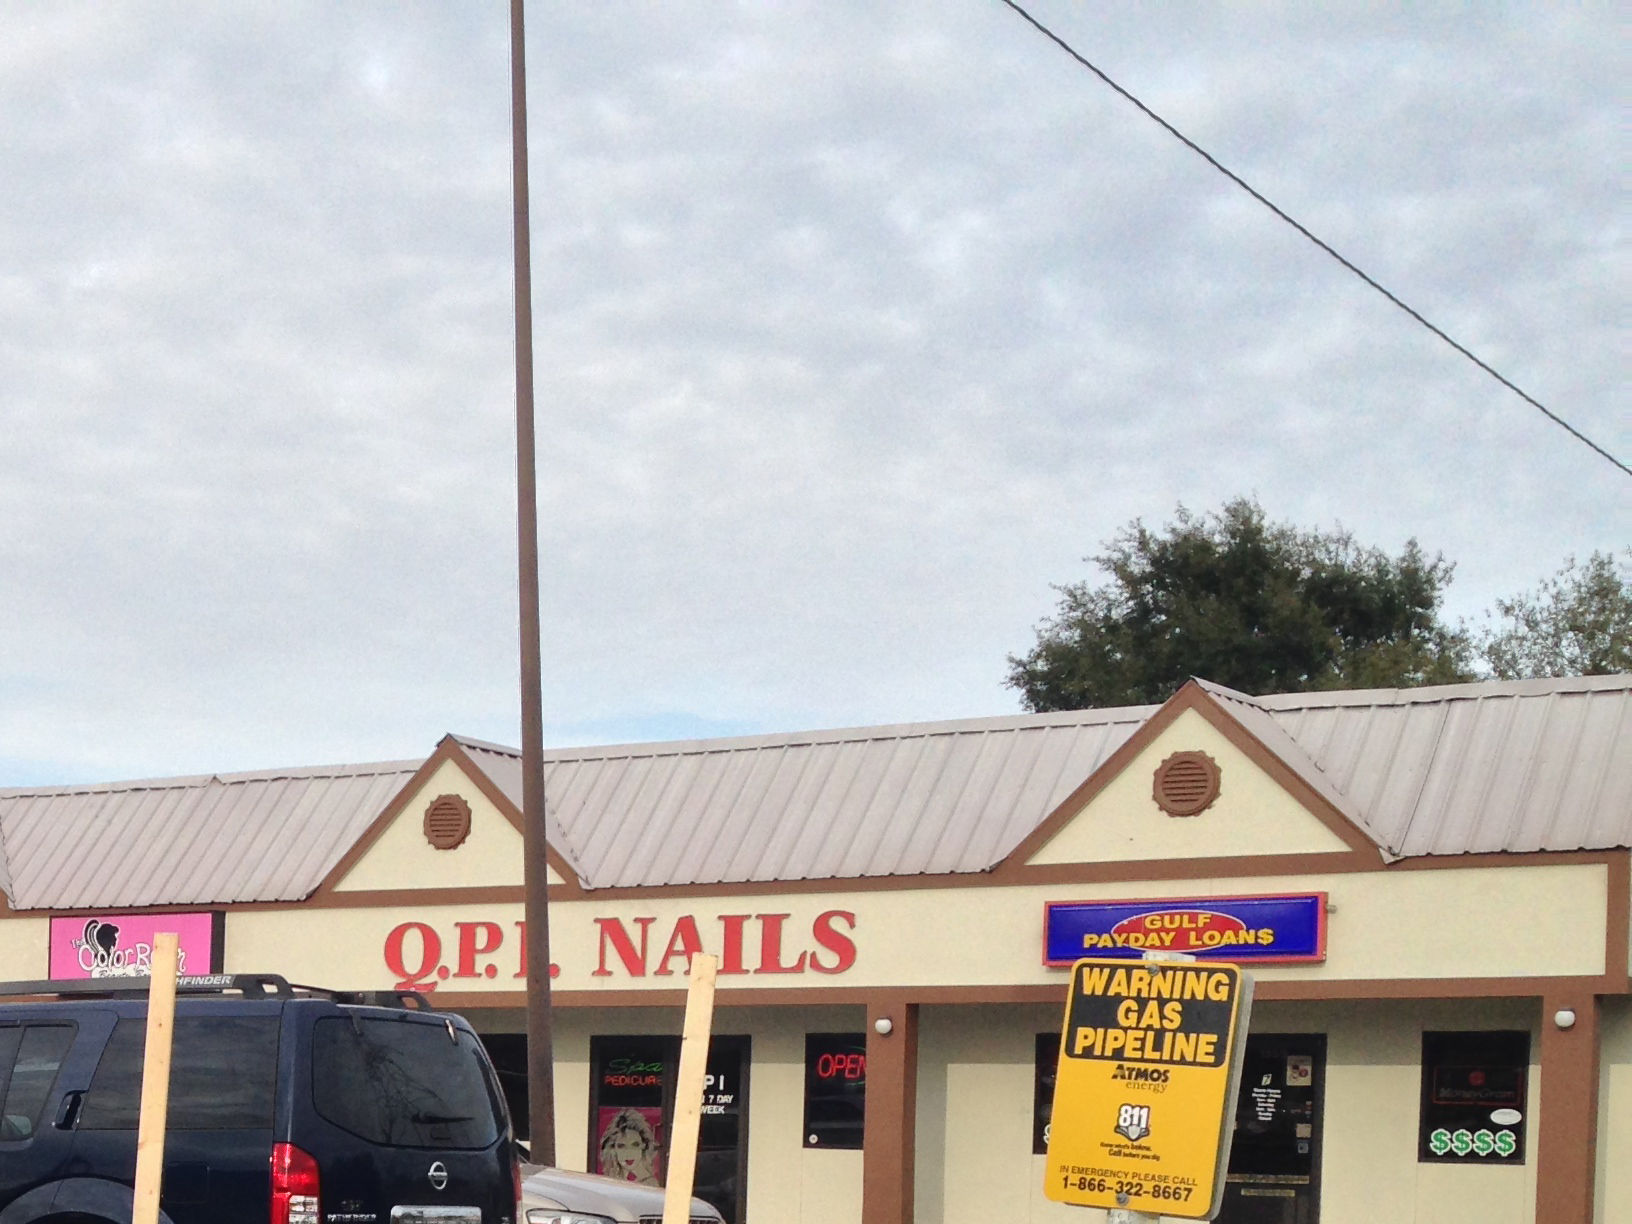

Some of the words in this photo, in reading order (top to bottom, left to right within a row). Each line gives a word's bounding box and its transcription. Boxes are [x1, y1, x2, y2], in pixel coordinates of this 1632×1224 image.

[1144, 914, 1212, 929] GULF
[592, 910, 857, 977] NAILS
[1083, 931, 1176, 948] PAYDAY
[78, 944, 134, 971] Color
[1082, 967, 1230, 1001] WARNING
[1118, 999, 1183, 1029] GAS
[1074, 1027, 1219, 1064] PIPELINE
[605, 1058, 663, 1076] Spa
[716, 1094, 734, 1104] DAY
[1125, 1081, 1168, 1094] energy
[1118, 1104, 1149, 1129] 811
[1060, 1165, 1069, 1173] IN
[1071, 1165, 1129, 1179] EMERGENCY
[1131, 1172, 1170, 1183] PLEASE
[1172, 1176, 1198, 1186] CALL
[1062, 1175, 1194, 1202] 1-866-322-8667
